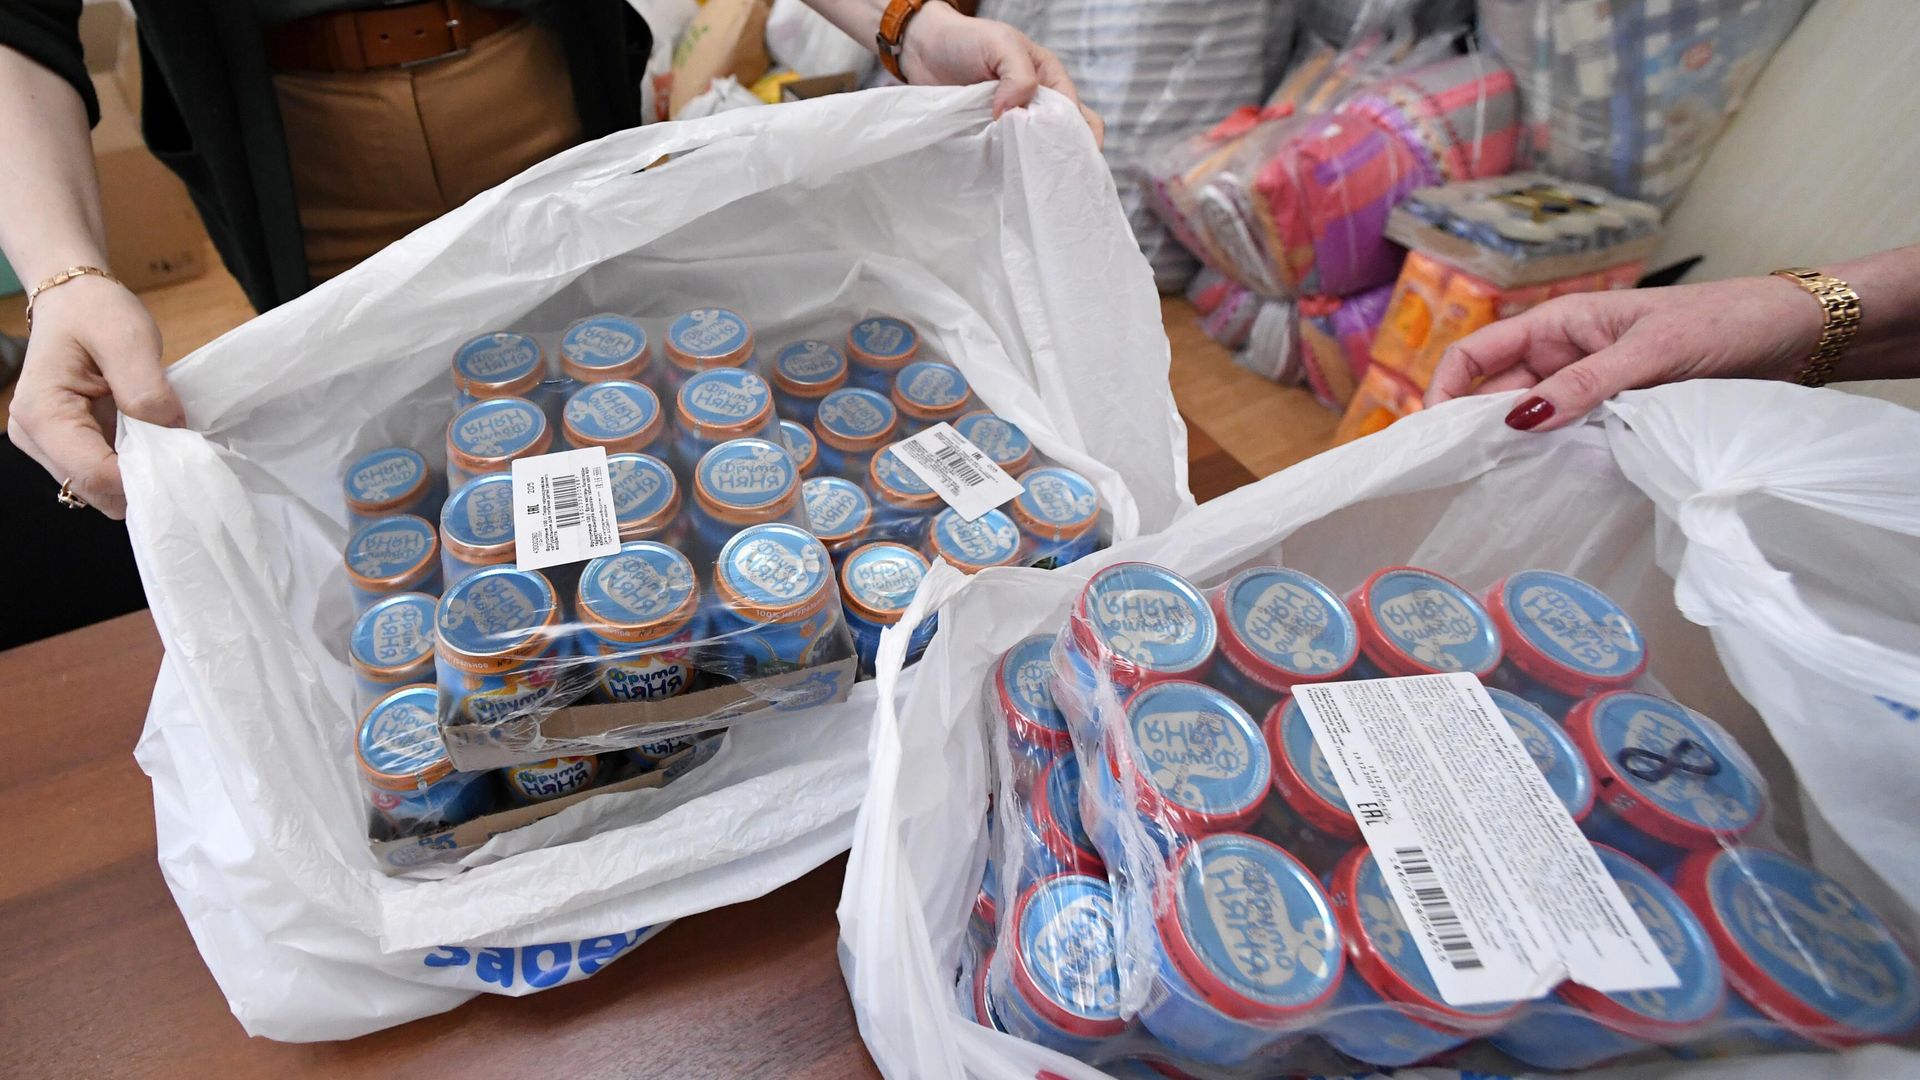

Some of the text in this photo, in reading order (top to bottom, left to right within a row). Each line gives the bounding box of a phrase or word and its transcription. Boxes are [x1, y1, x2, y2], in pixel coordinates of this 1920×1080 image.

[720, 461, 779, 474] Фруто
[607, 665, 679, 684] Фруто
[519, 761, 584, 784] Фруто
